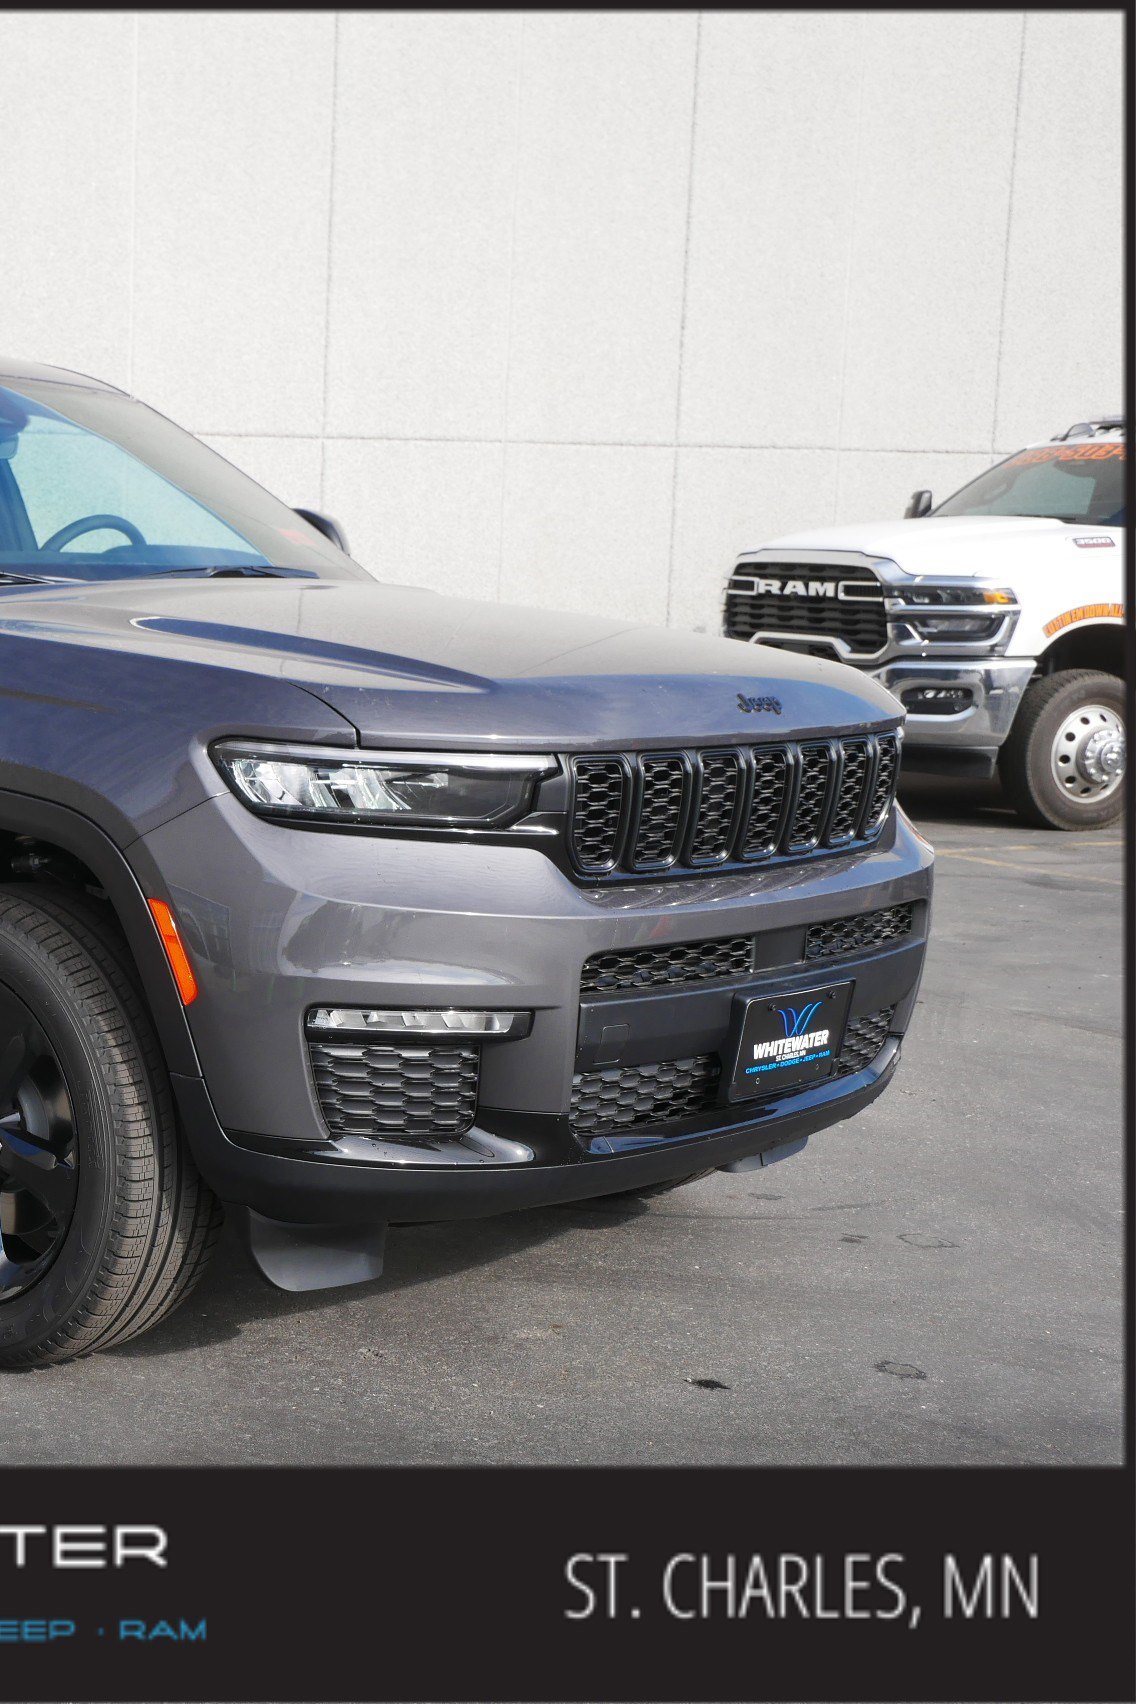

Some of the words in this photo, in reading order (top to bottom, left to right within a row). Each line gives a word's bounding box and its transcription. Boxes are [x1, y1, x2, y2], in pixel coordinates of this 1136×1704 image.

[758, 578, 836, 598] RAM
[737, 693, 782, 716] Jeep
[753, 1029, 830, 1060] WHITEWATER
[745, 1063, 777, 1074] CHRYSLER
[780, 1058, 800, 1068] DODGE
[818, 1050, 831, 1058] RAM
